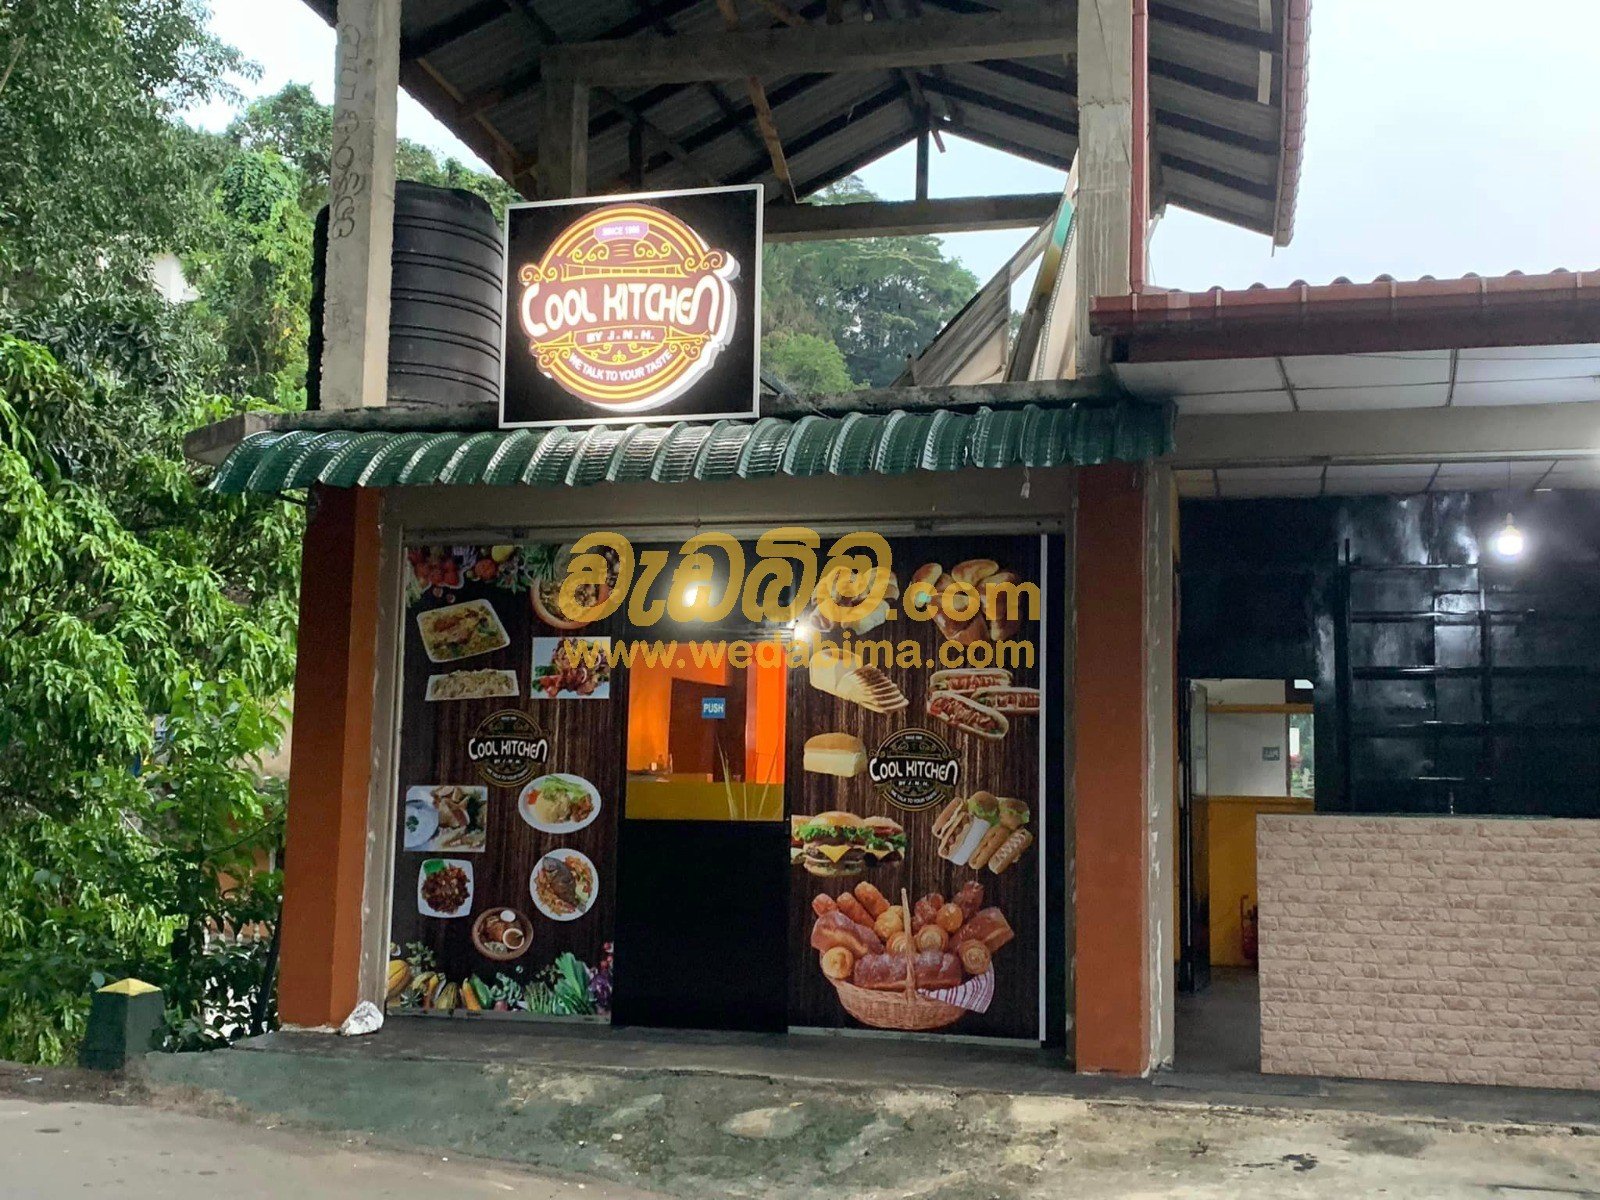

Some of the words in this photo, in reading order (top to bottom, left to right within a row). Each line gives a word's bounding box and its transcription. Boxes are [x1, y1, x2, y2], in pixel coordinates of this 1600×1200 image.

[521, 281, 597, 337] COOL
[602, 274, 720, 333] KITCHEN
[586, 331, 603, 343] BY
[569, 353, 582, 371] WE
[582, 362, 604, 380] TALK
[605, 369, 618, 381] TO
[619, 366, 646, 381] YOUR
[645, 348, 673, 375] TASTE
[703, 702, 725, 714] PUSH
[468, 737, 499, 760] COOL
[500, 738, 548, 763] KITCHEN
[869, 757, 904, 782] COOL
[905, 759, 959, 785] KITCHEN
